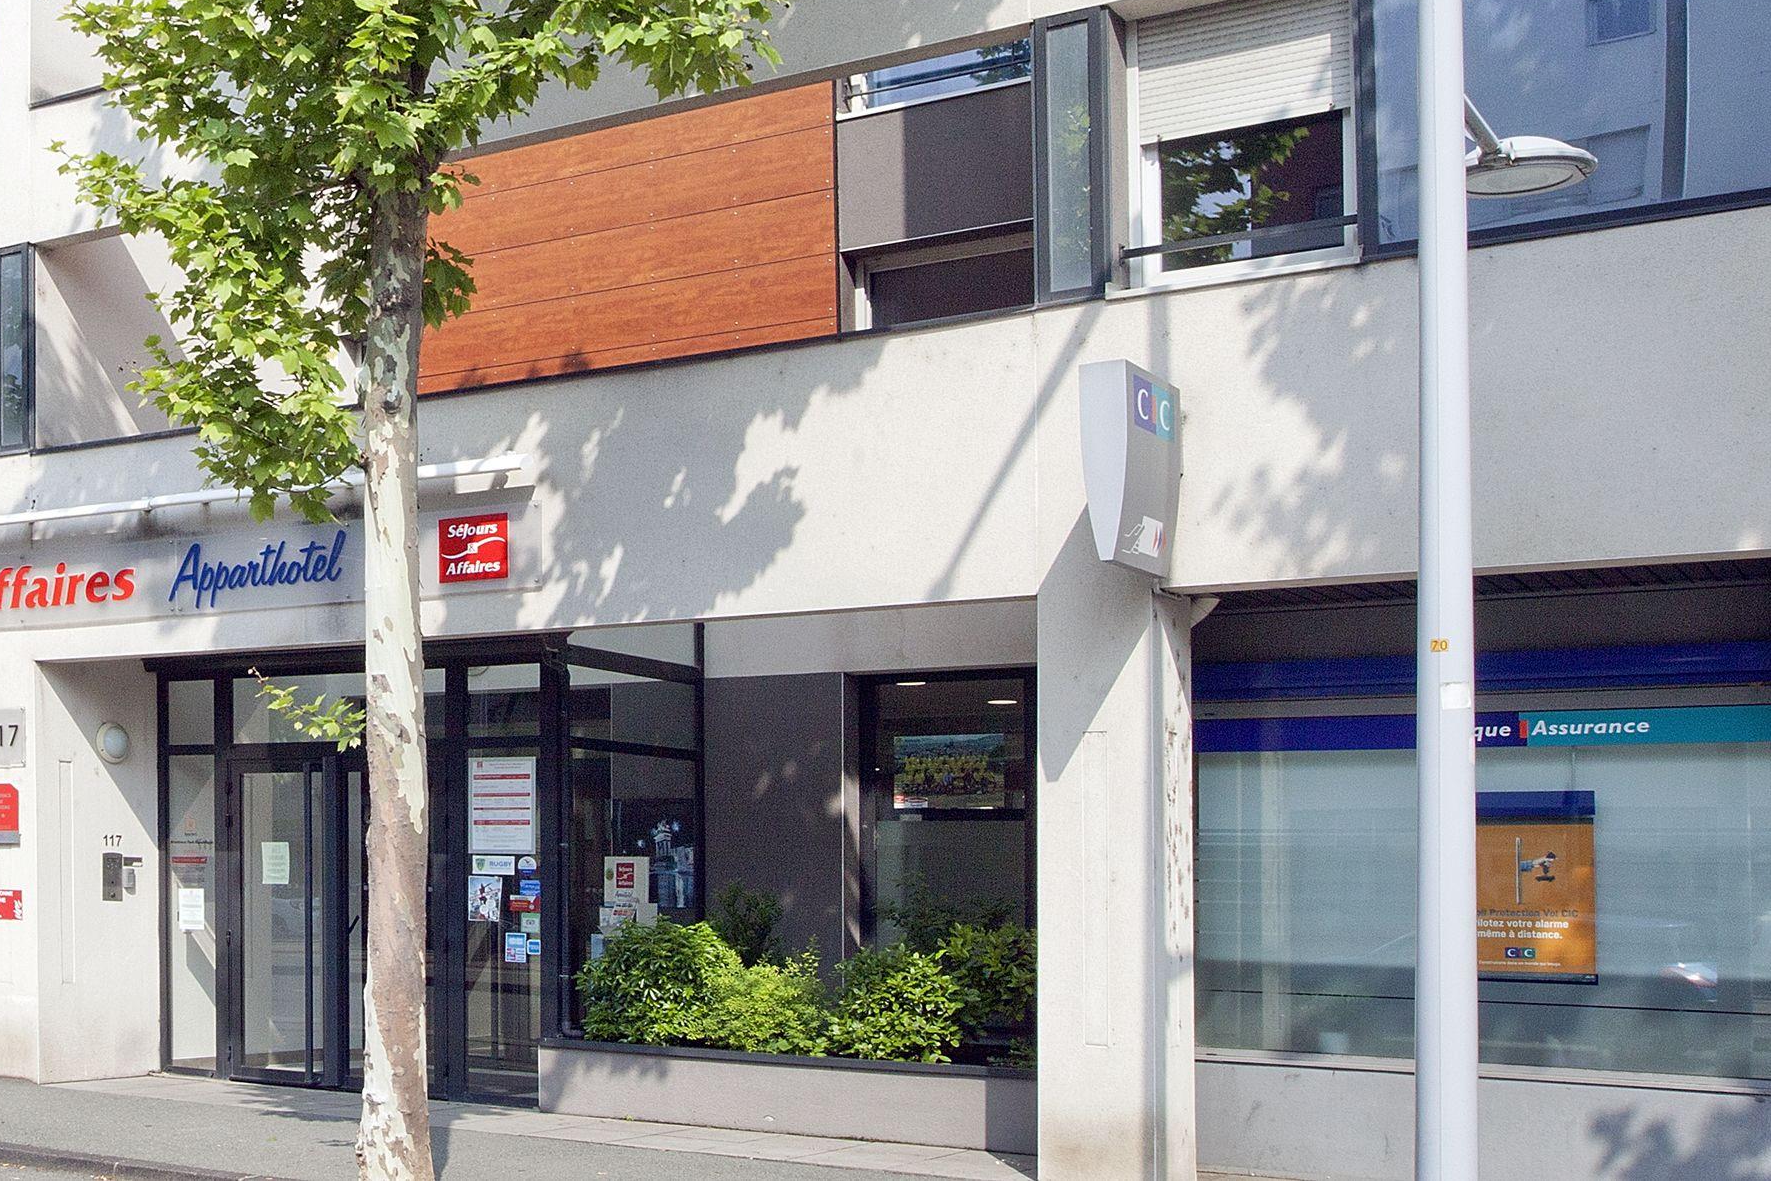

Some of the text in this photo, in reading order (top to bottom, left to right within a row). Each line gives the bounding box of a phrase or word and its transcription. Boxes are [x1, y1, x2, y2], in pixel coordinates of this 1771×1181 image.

[1137, 388, 1170, 431] CIC
[448, 522, 498, 539] Séjours
[168, 529, 347, 609] Apparthotel
[445, 560, 501, 577] Affaires
[1431, 640, 1448, 650] 70
[1474, 720, 1651, 742] que Assurance
[102, 835, 123, 847] 117
[1489, 908, 1541, 918] Protection
[1477, 920, 1569, 929] ilotez votre alarme
[1508, 930, 1516, 938] à
[1518, 930, 1563, 939] distance.
